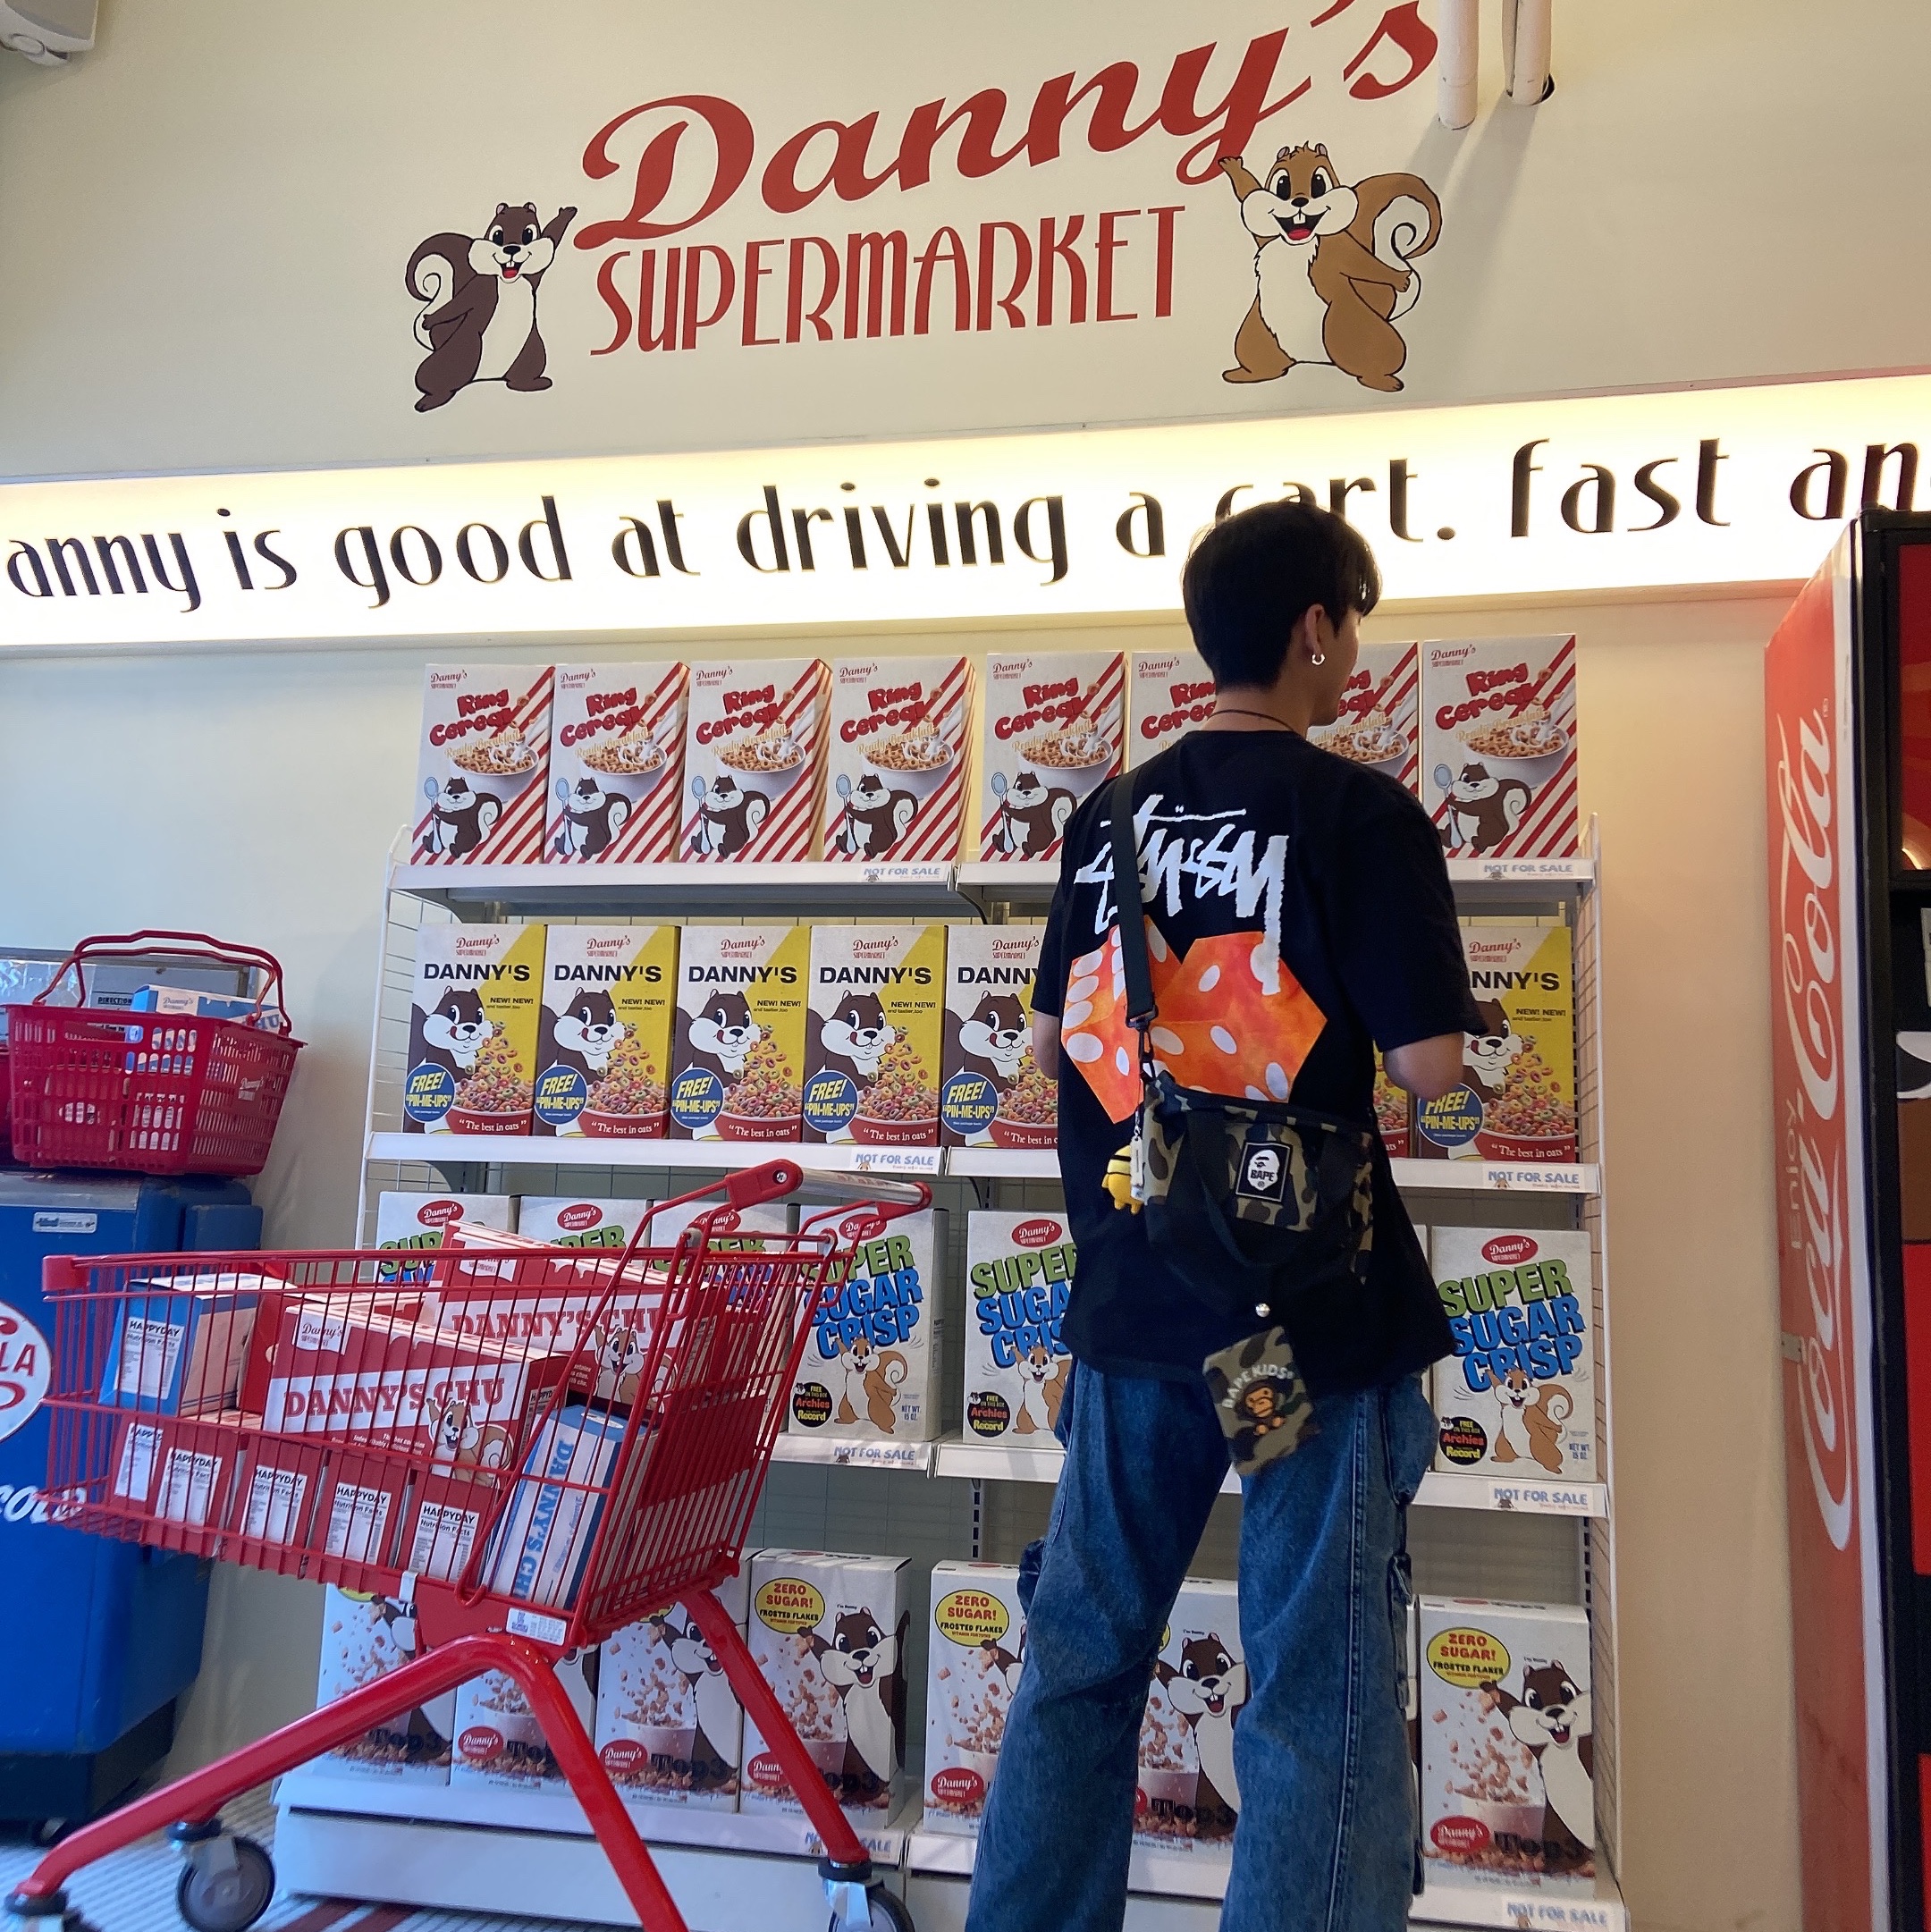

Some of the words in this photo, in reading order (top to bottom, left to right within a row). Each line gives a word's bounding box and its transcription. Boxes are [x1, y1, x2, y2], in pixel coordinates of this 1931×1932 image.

[574, 0, 1438, 249] Danny's
[590, 206, 1186, 357] SUPERMARKET
[216, 507, 298, 590] is
[334, 494, 573, 609] good
[611, 499, 701, 578] at
[736, 477, 1069, 586] driving
[1116, 491, 1166, 558] a
[1510, 437, 1730, 538] fast
[1790, 442, 1931, 520] an
[1430, 644, 1476, 660] Danny's
[840, 662, 878, 678] Danny's
[992, 658, 1033, 673] Danny's
[1139, 656, 1180, 671] Danny's
[696, 666, 733, 681] Danny's
[1466, 662, 1528, 696] Ring
[723, 684, 775, 714] Ring
[868, 682, 922, 713] Ring
[1023, 677, 1079, 709] Ring
[457, 689, 510, 717] Ring
[586, 688, 637, 716] Ring
[1436, 682, 1535, 730] Cereal
[560, 705, 644, 747] Cereal
[696, 703, 781, 745] Cereal
[839, 701, 929, 742] Cereal
[994, 696, 1086, 740] Cereal
[429, 707, 513, 747] Cereal
[864, 867, 885, 877] NOT
[888, 867, 908, 876] FOR
[911, 867, 940, 876] SALE
[1484, 864, 1507, 873] NOT
[1512, 864, 1535, 873] FOR
[1539, 864, 1573, 873] SALE
[456, 934, 500, 949] Danny's
[586, 935, 630, 949] Danny's
[721, 936, 765, 951] Danny's
[853, 936, 898, 952] Danny's
[992, 936, 1040, 951] Danny's
[1469, 939, 1522, 955] Danny's
[424, 963, 530, 981] DANNY'S
[554, 965, 662, 983] DANNY'S
[688, 966, 797, 983] DANNY'S
[820, 967, 932, 984] DANNY'S
[512, 997, 534, 1005] NEW!
[621, 998, 642, 1006] NEW!
[645, 999, 665, 1007] NEW!
[1516, 1008, 1539, 1016] NEW!
[1542, 1008, 1566, 1017] NEW!
[409, 1072, 446, 1093] FREE!
[540, 1073, 578, 1095] FREE!
[676, 1076, 713, 1100] FREE!
[808, 1079, 847, 1102] FREE!
[947, 1081, 987, 1104] FREE!
[612, 1123, 627, 1135] best
[628, 1124, 637, 1134] in
[751, 1126, 763, 1137] best
[766, 1127, 774, 1137] in
[886, 1130, 899, 1142] best
[901, 1131, 910, 1141] in
[1777, 707, 1853, 1552] Coca-Cola
[856, 1153, 878, 1164] NOT
[880, 1154, 902, 1164] FOR
[905, 1155, 934, 1166] SALE
[1250, 1169, 1275, 1183] BAPE
[1488, 1170, 1513, 1181] NOT
[1516, 1171, 1541, 1182] FOR
[1545, 1172, 1579, 1184] SALE
[424, 1203, 458, 1218] Danny's
[563, 1207, 596, 1222] Danny's
[1018, 1221, 1056, 1238] Danny's
[1489, 1238, 1530, 1255] Danny's
[1438, 1258, 1574, 1318] SUPER
[976, 1282, 1071, 1336] SUGA
[130, 1320, 180, 1336] HAPPYDAY
[302, 1322, 342, 1338] Danny's
[451, 1309, 591, 1338] DANNY'S
[1447, 1295, 1585, 1357] SUGAR
[816, 1304, 919, 1360] CRISP
[1463, 1334, 1583, 1393] CRISP
[1222, 1371, 1251, 1409] BAPE
[1252, 1363, 1287, 1379] KIDS
[283, 1382, 425, 1418] DANNY'S
[433, 1377, 505, 1409] CHU
[796, 1397, 830, 1409] Archies
[797, 1410, 826, 1422] Record
[971, 1407, 1007, 1419] Archies
[973, 1419, 1004, 1431] Record
[1442, 1431, 1484, 1446] Archies
[834, 1446, 856, 1458] NOT
[858, 1448, 881, 1459] FOR
[884, 1450, 915, 1460] SALE
[1446, 1445, 1481, 1459] Record
[337, 1486, 387, 1505] HAPPYDAY
[1494, 1487, 1519, 1500] NOT
[1522, 1489, 1548, 1502] FOR
[1552, 1491, 1587, 1505] SALE
[423, 1505, 476, 1524] HAPPYDAY
[774, 1583, 806, 1595] ZERO
[766, 1595, 813, 1608] SUGAR!
[956, 1596, 990, 1607] ZERO
[760, 1609, 790, 1620] FROSTED
[792, 1613, 819, 1622] FLAKES
[948, 1607, 998, 1621] SUGAR!
[940, 1622, 973, 1632] FROSTED
[975, 1624, 1003, 1634] FLAKES
[1447, 1633, 1488, 1647] ZERO
[1440, 1646, 1496, 1662] SUGAR!
[1433, 1660, 1471, 1673] FROSTED
[1473, 1665, 1505, 1676] FLAKES
[463, 1734, 498, 1749] Danny's
[605, 1747, 642, 1761] Danny's
[937, 1776, 977, 1791] Danny's
